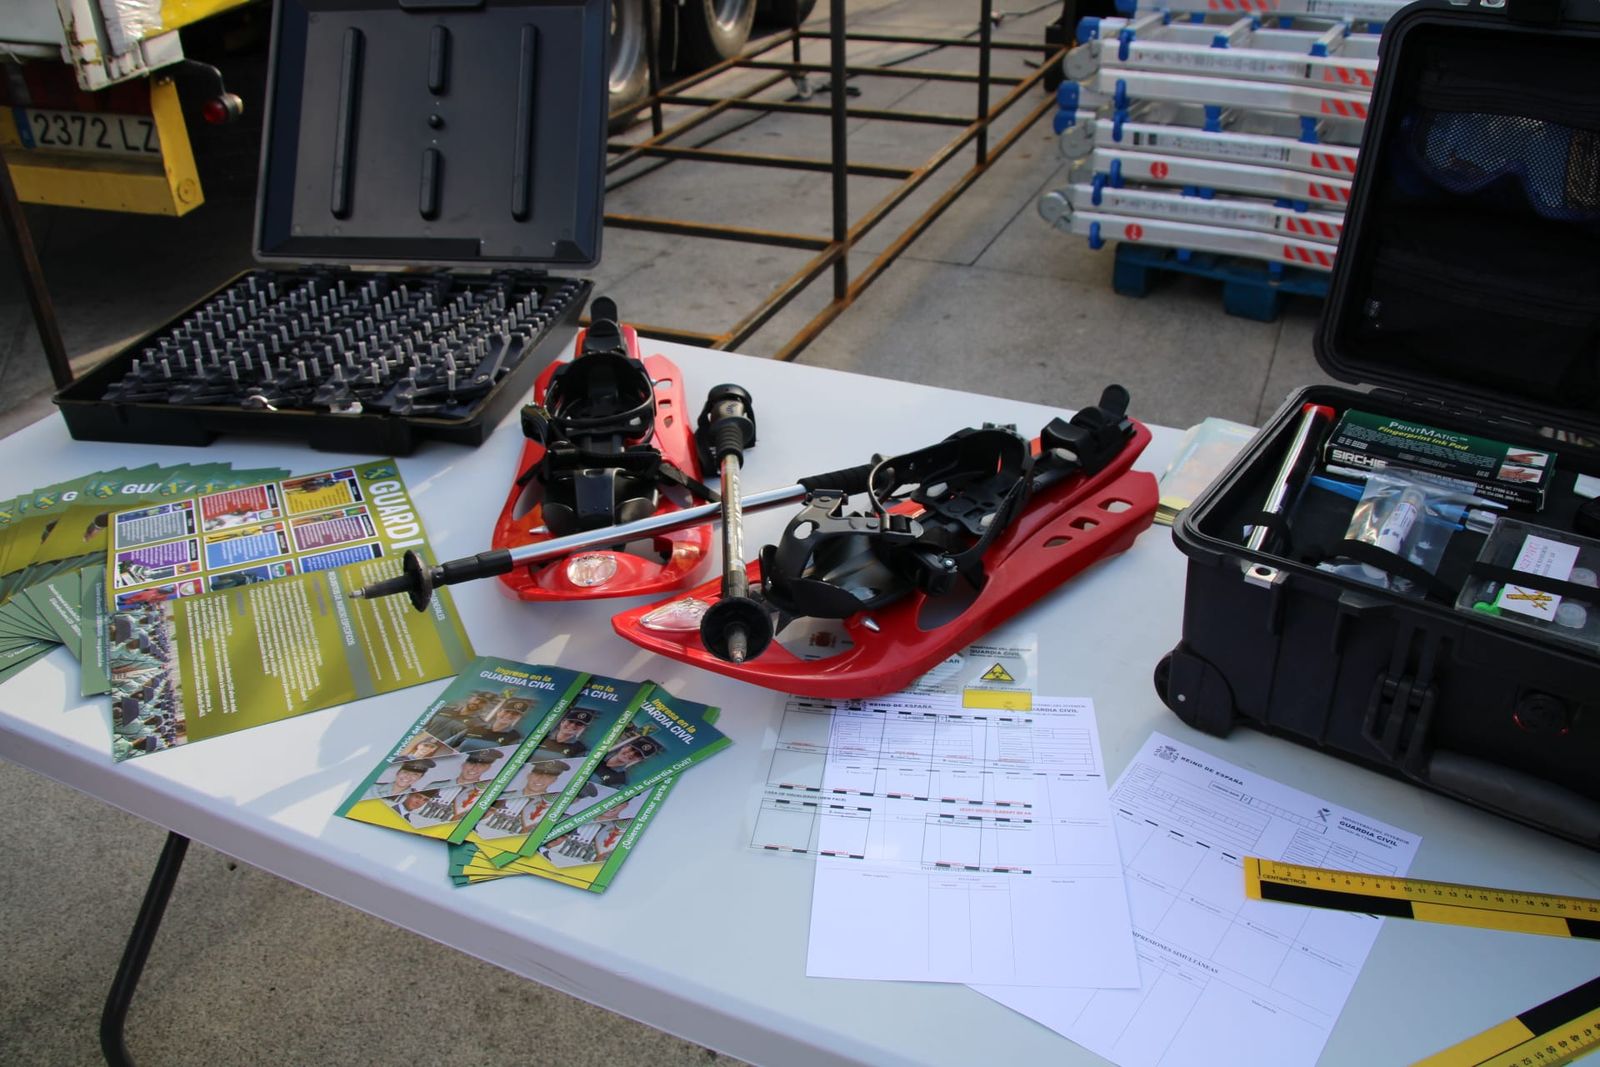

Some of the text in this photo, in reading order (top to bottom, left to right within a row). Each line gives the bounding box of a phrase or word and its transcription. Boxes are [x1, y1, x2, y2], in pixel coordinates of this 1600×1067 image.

[33, 113, 112, 149] 2372
[1378, 425, 1431, 442] Fingerprint
[1431, 437, 1447, 446] Ink
[1448, 441, 1470, 451] Pad
[368, 480, 425, 550] GUARDI
[479, 670, 556, 691] GUARDIA CIVIL
[590, 690, 620, 702] CIVIL
[670, 724, 695, 745] CIVIL
[573, 806, 602, 823] formar
[602, 795, 624, 810] parte
[624, 789, 635, 797] de
[635, 784, 645, 792] la
[643, 769, 673, 787] Guardia
[672, 757, 692, 771] Civil?
[1339, 820, 1374, 838] GUARDIA
[1376, 835, 1398, 847] CIVIL
[1262, 873, 1306, 885] CENTIMETROS
